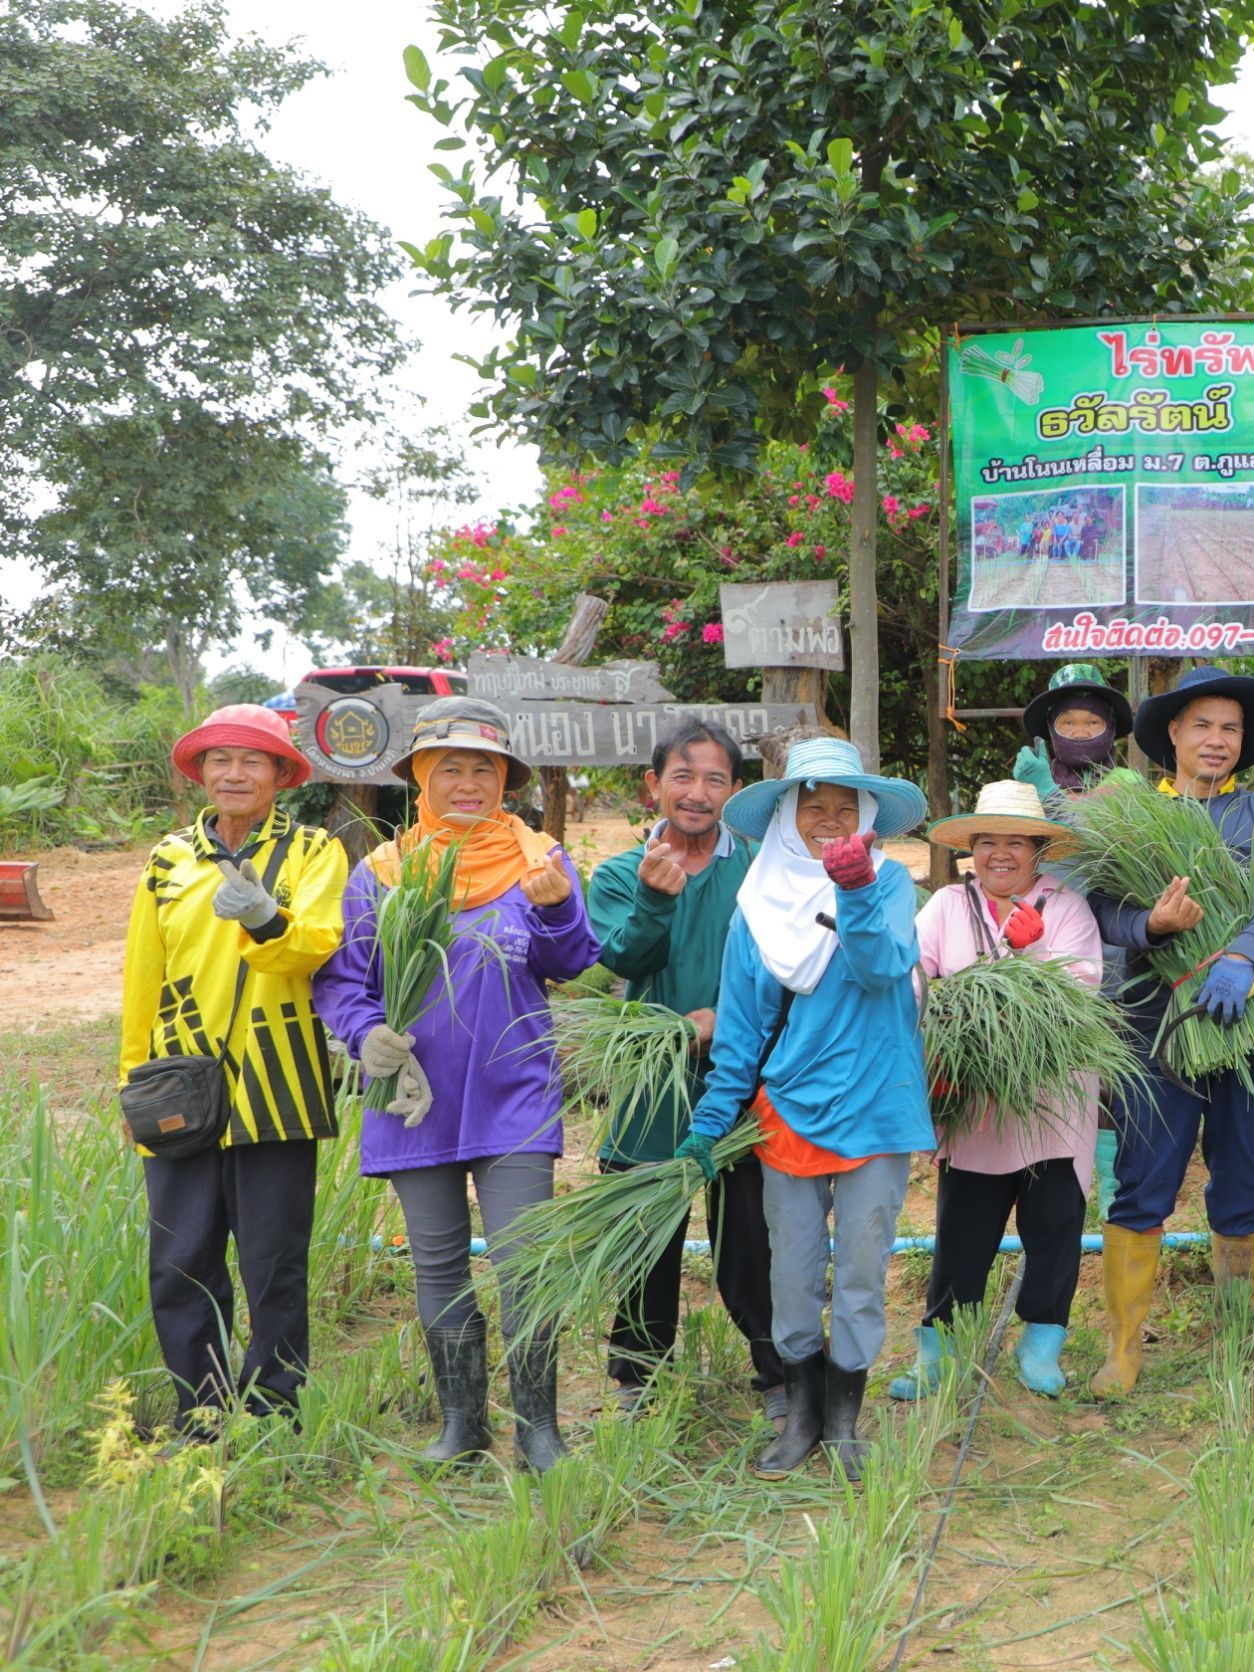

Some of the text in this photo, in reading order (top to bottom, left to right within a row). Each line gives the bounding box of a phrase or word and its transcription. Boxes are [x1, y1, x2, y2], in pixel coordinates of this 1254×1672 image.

[1040, 385, 1232, 438] ธวัลรัตน์
[982, 446, 1134, 483] บ้านโนนเหลื่อม
[1143, 453, 1184, 471] ม.7
[611, 711, 658, 757] นา
